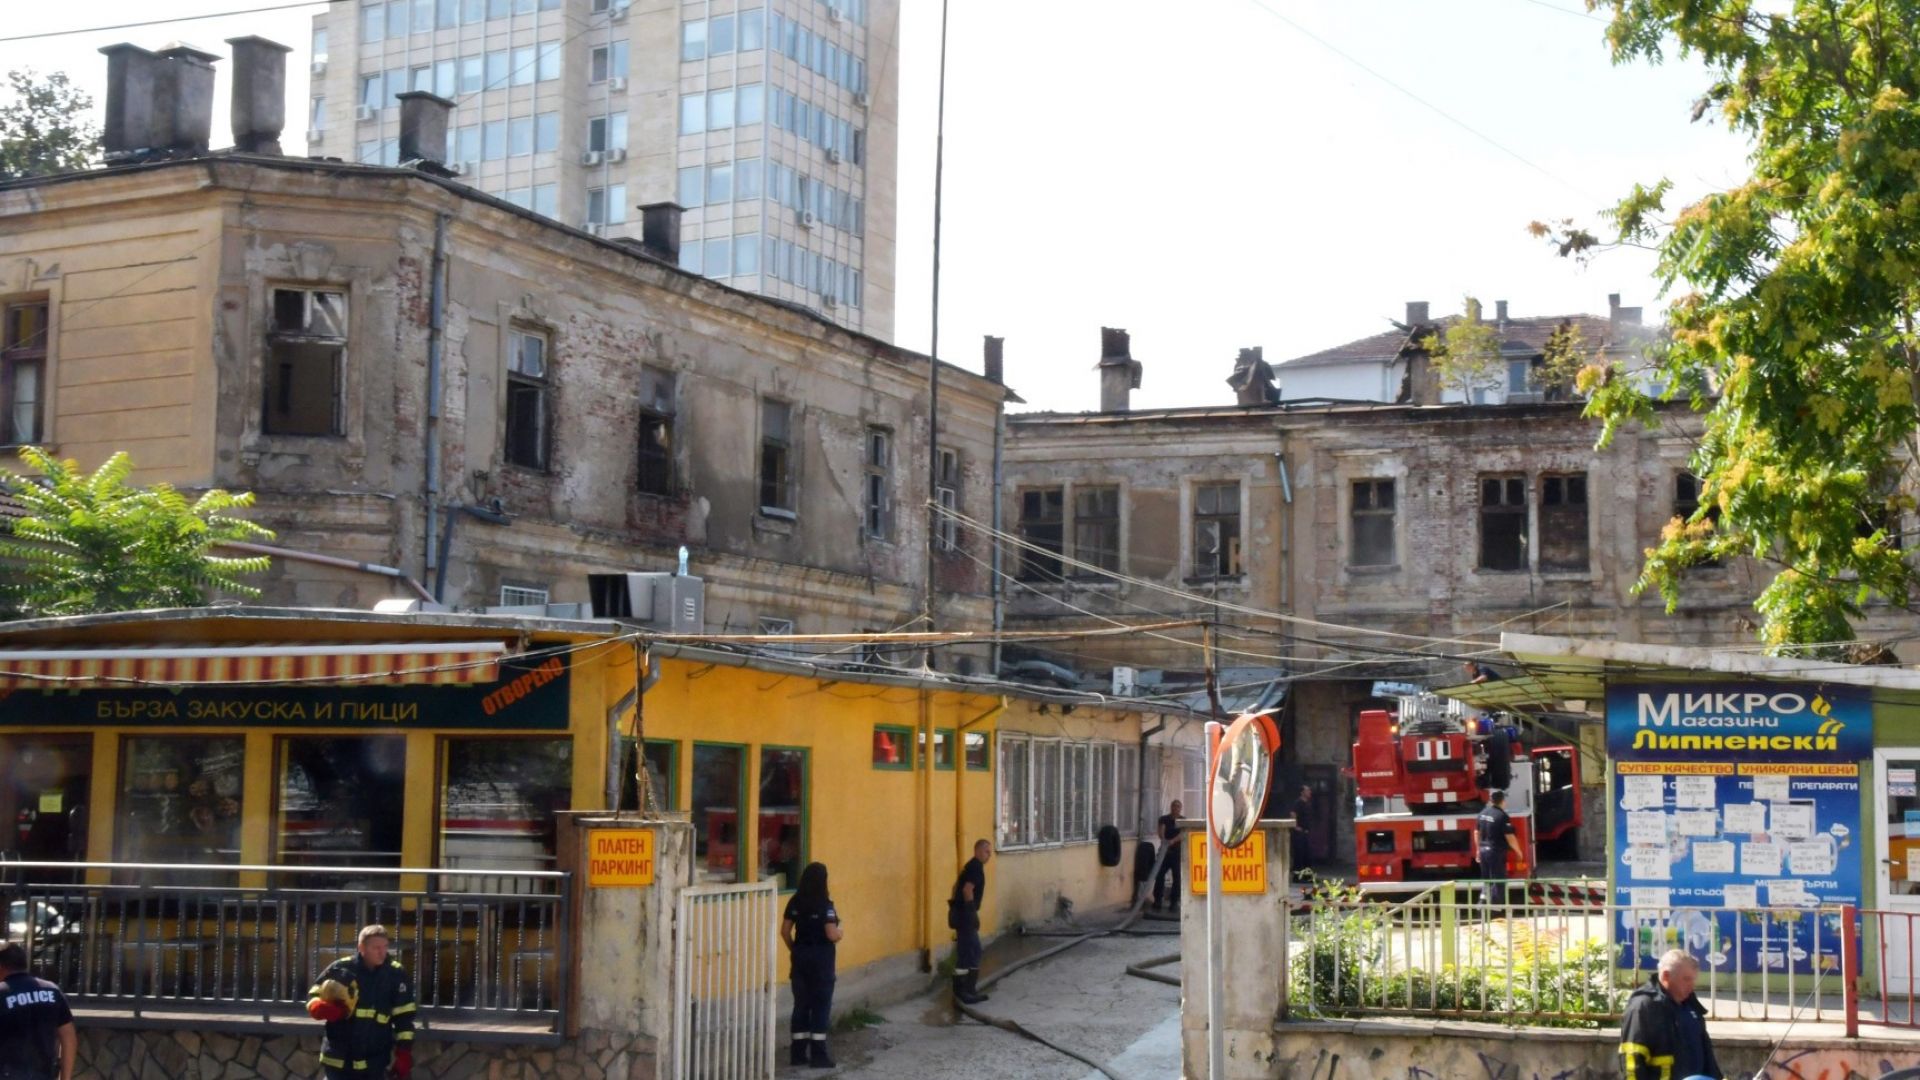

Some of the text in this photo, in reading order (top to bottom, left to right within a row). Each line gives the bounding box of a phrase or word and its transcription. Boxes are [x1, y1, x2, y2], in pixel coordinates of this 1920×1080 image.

[482, 656, 564, 716] ОТВОРЕНО
[97, 701, 418, 722] БЪРЗА ЗАКУСКА И ПИЦИ
[1638, 693, 1806, 726] МИКРО
[1632, 729, 1837, 750] Липненски
[1619, 764, 1733, 774] СУПЕР КАЧЕСТВО
[1742, 766, 1855, 776] УНИКАЛНИ ЦЕНИ
[1792, 782, 1858, 790] ПРЕПАРАТИ
[598, 839, 645, 854] ПЛАТЕН
[592, 860, 651, 875] ПАРКИНГ
[5, 990, 56, 1009] POLICE
